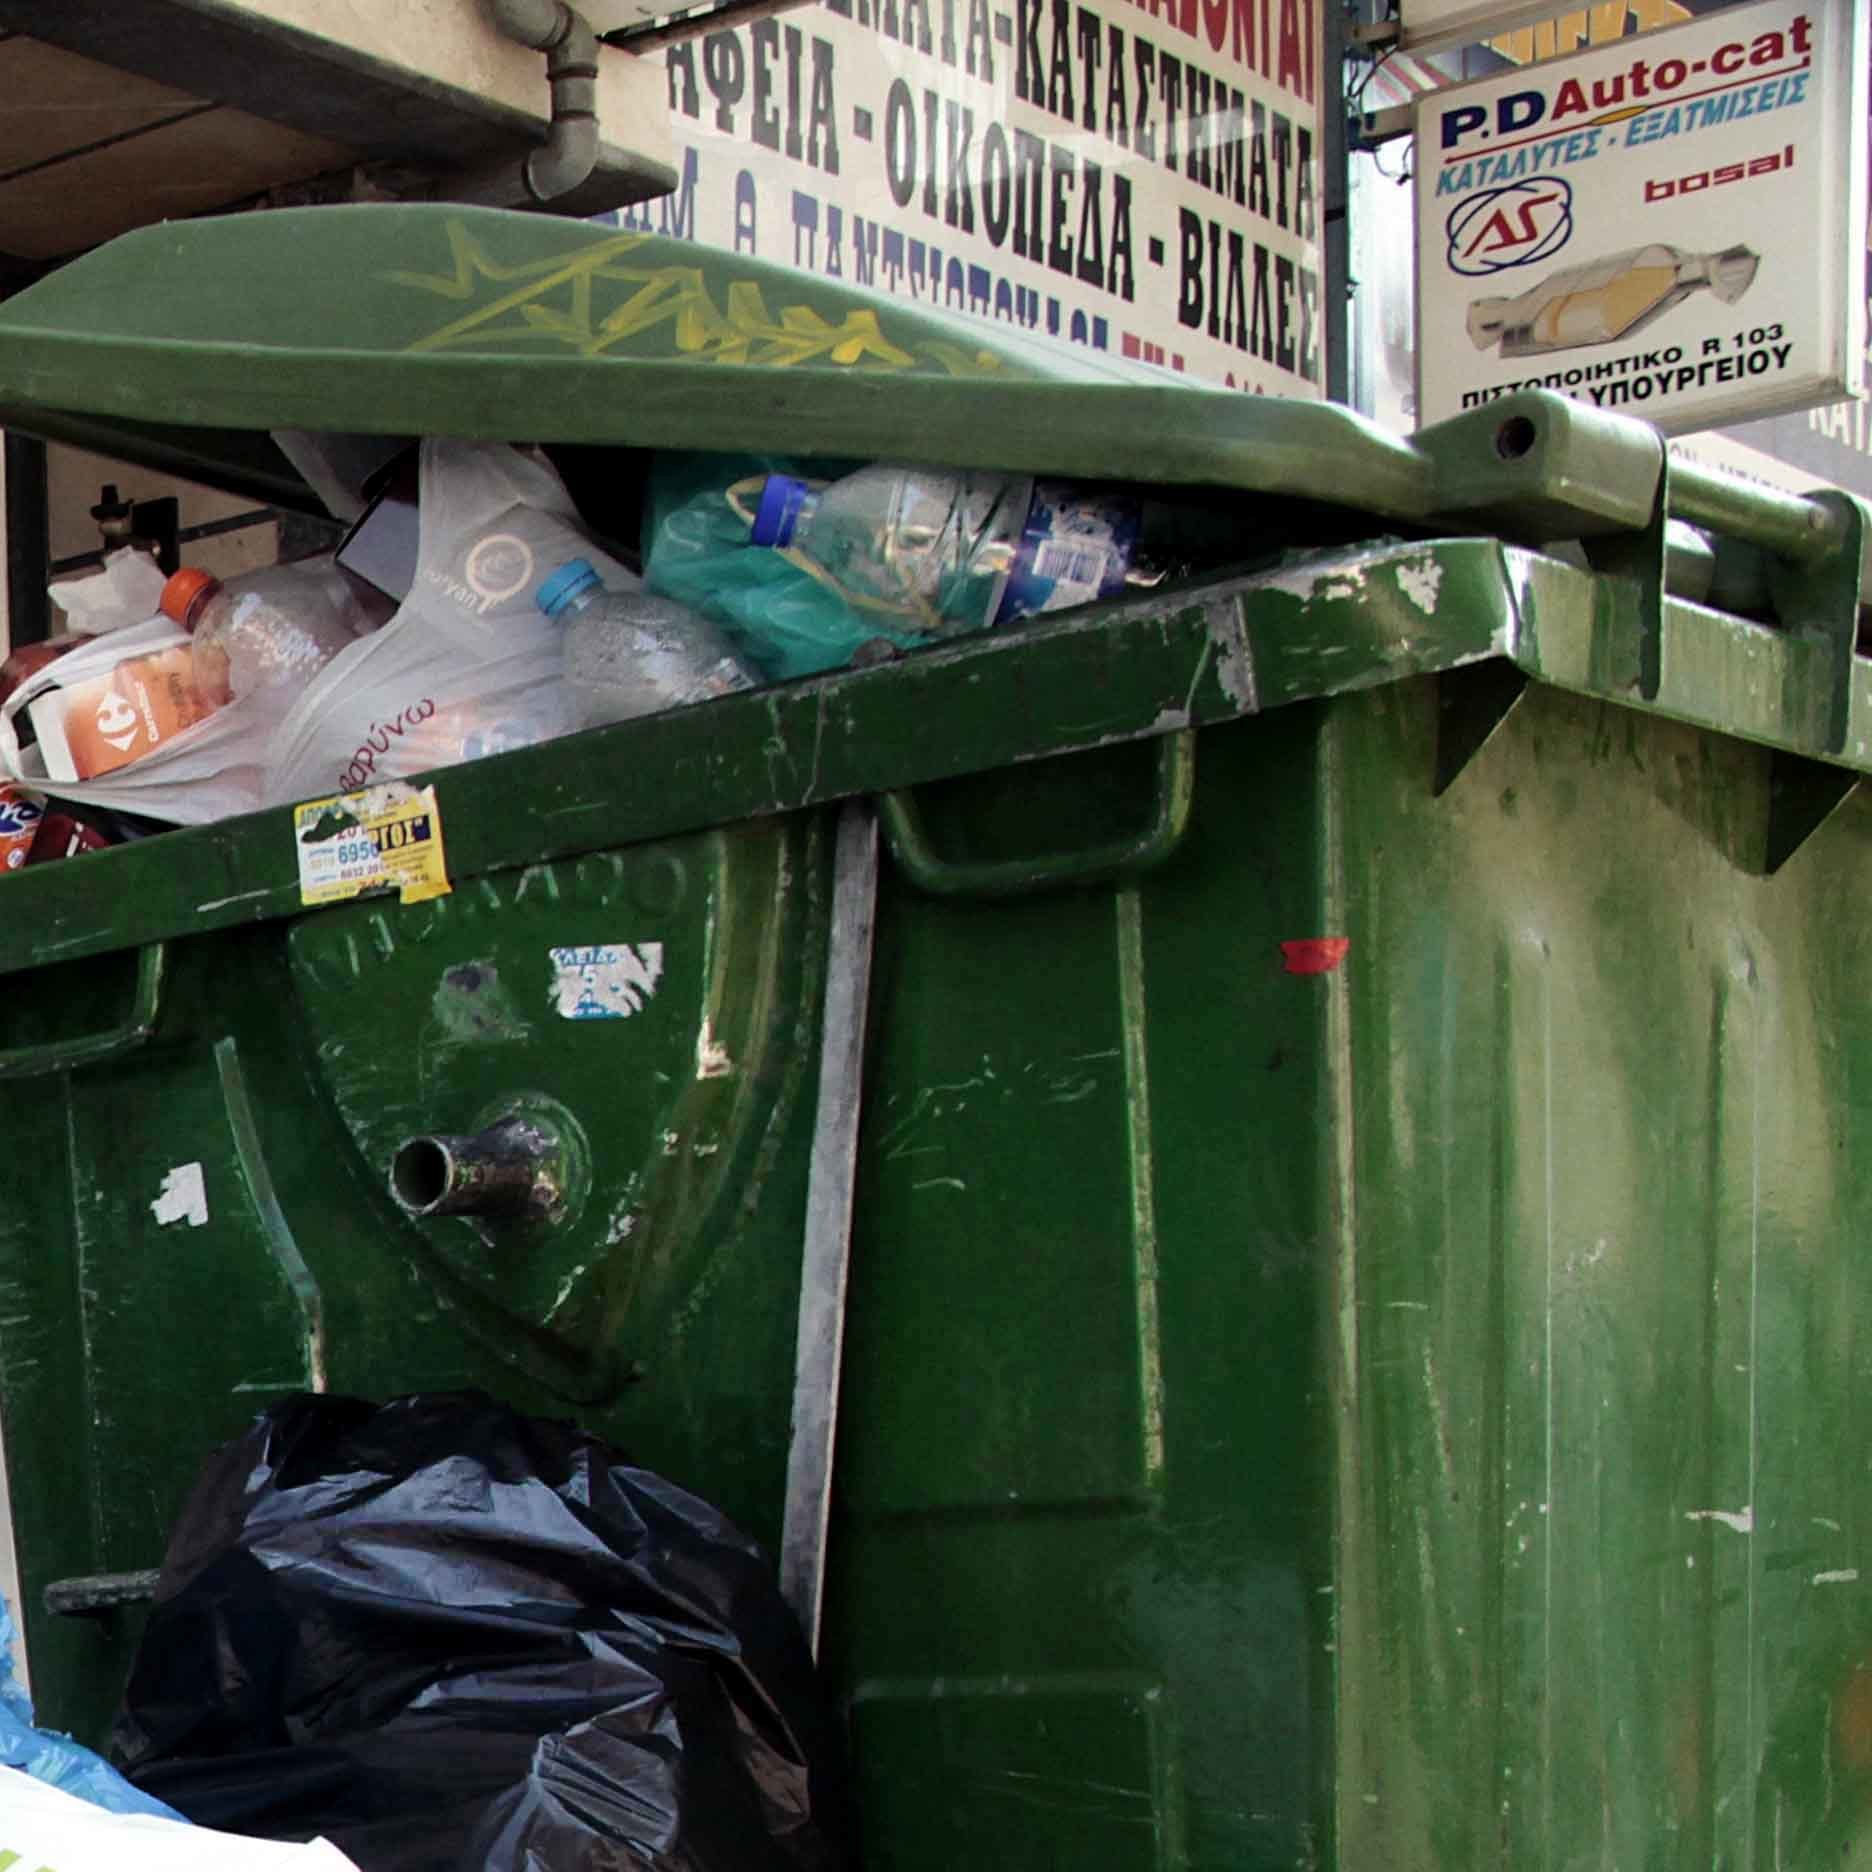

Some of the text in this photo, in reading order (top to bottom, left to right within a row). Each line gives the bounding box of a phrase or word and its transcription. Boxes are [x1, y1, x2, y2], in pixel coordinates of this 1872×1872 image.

[1435, 72, 1811, 198] ΚΑΤΑΛΥΤΕΣ ΕΞΑΤΜΙΣΕΙΣ
[667, 8, 839, 176] ΑΦΕΙΑ
[885, 77, 1135, 303] ΟΙΚΟΠΕΔΑ
[1178, 206, 1319, 383] ΒΙΛΛΕΣ
[1644, 145, 1794, 203] bosal
[1702, 338, 1721, 356] R
[1732, 324, 1786, 349] 103
[1588, 344, 1794, 408] ΥΠΟΥΡΓΕΙΟΥ
